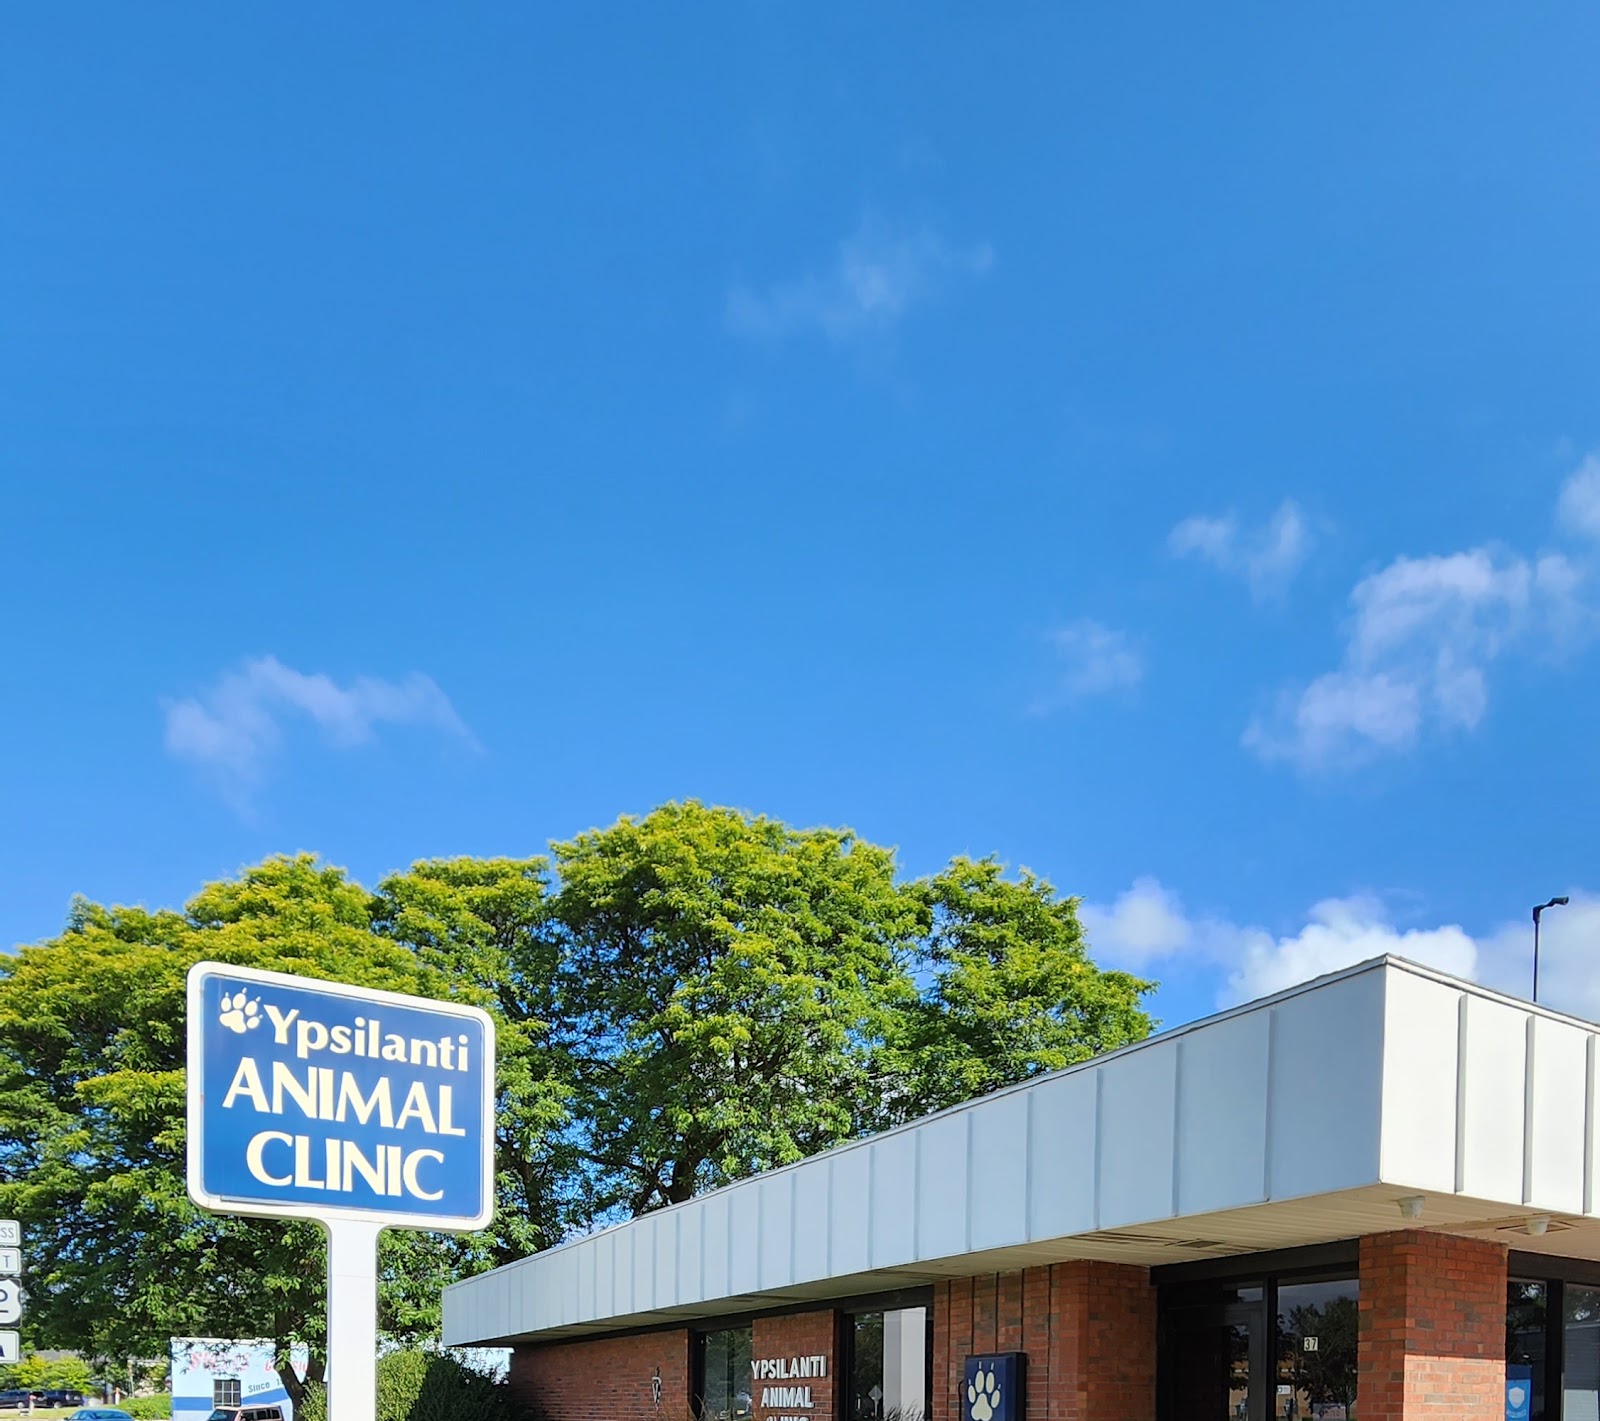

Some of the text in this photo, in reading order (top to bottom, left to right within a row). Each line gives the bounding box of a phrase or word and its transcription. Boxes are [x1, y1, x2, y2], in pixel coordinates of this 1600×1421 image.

[263, 1004, 469, 1073] Ypsilanti
[222, 1056, 466, 1137] ANIMAL
[246, 1131, 445, 1201] CLINIC
[1305, 1338, 1317, 1350] 37
[751, 1356, 827, 1380] YPSILANTI
[248, 1382, 271, 1393] Since
[761, 1386, 815, 1409] ANIMAL
